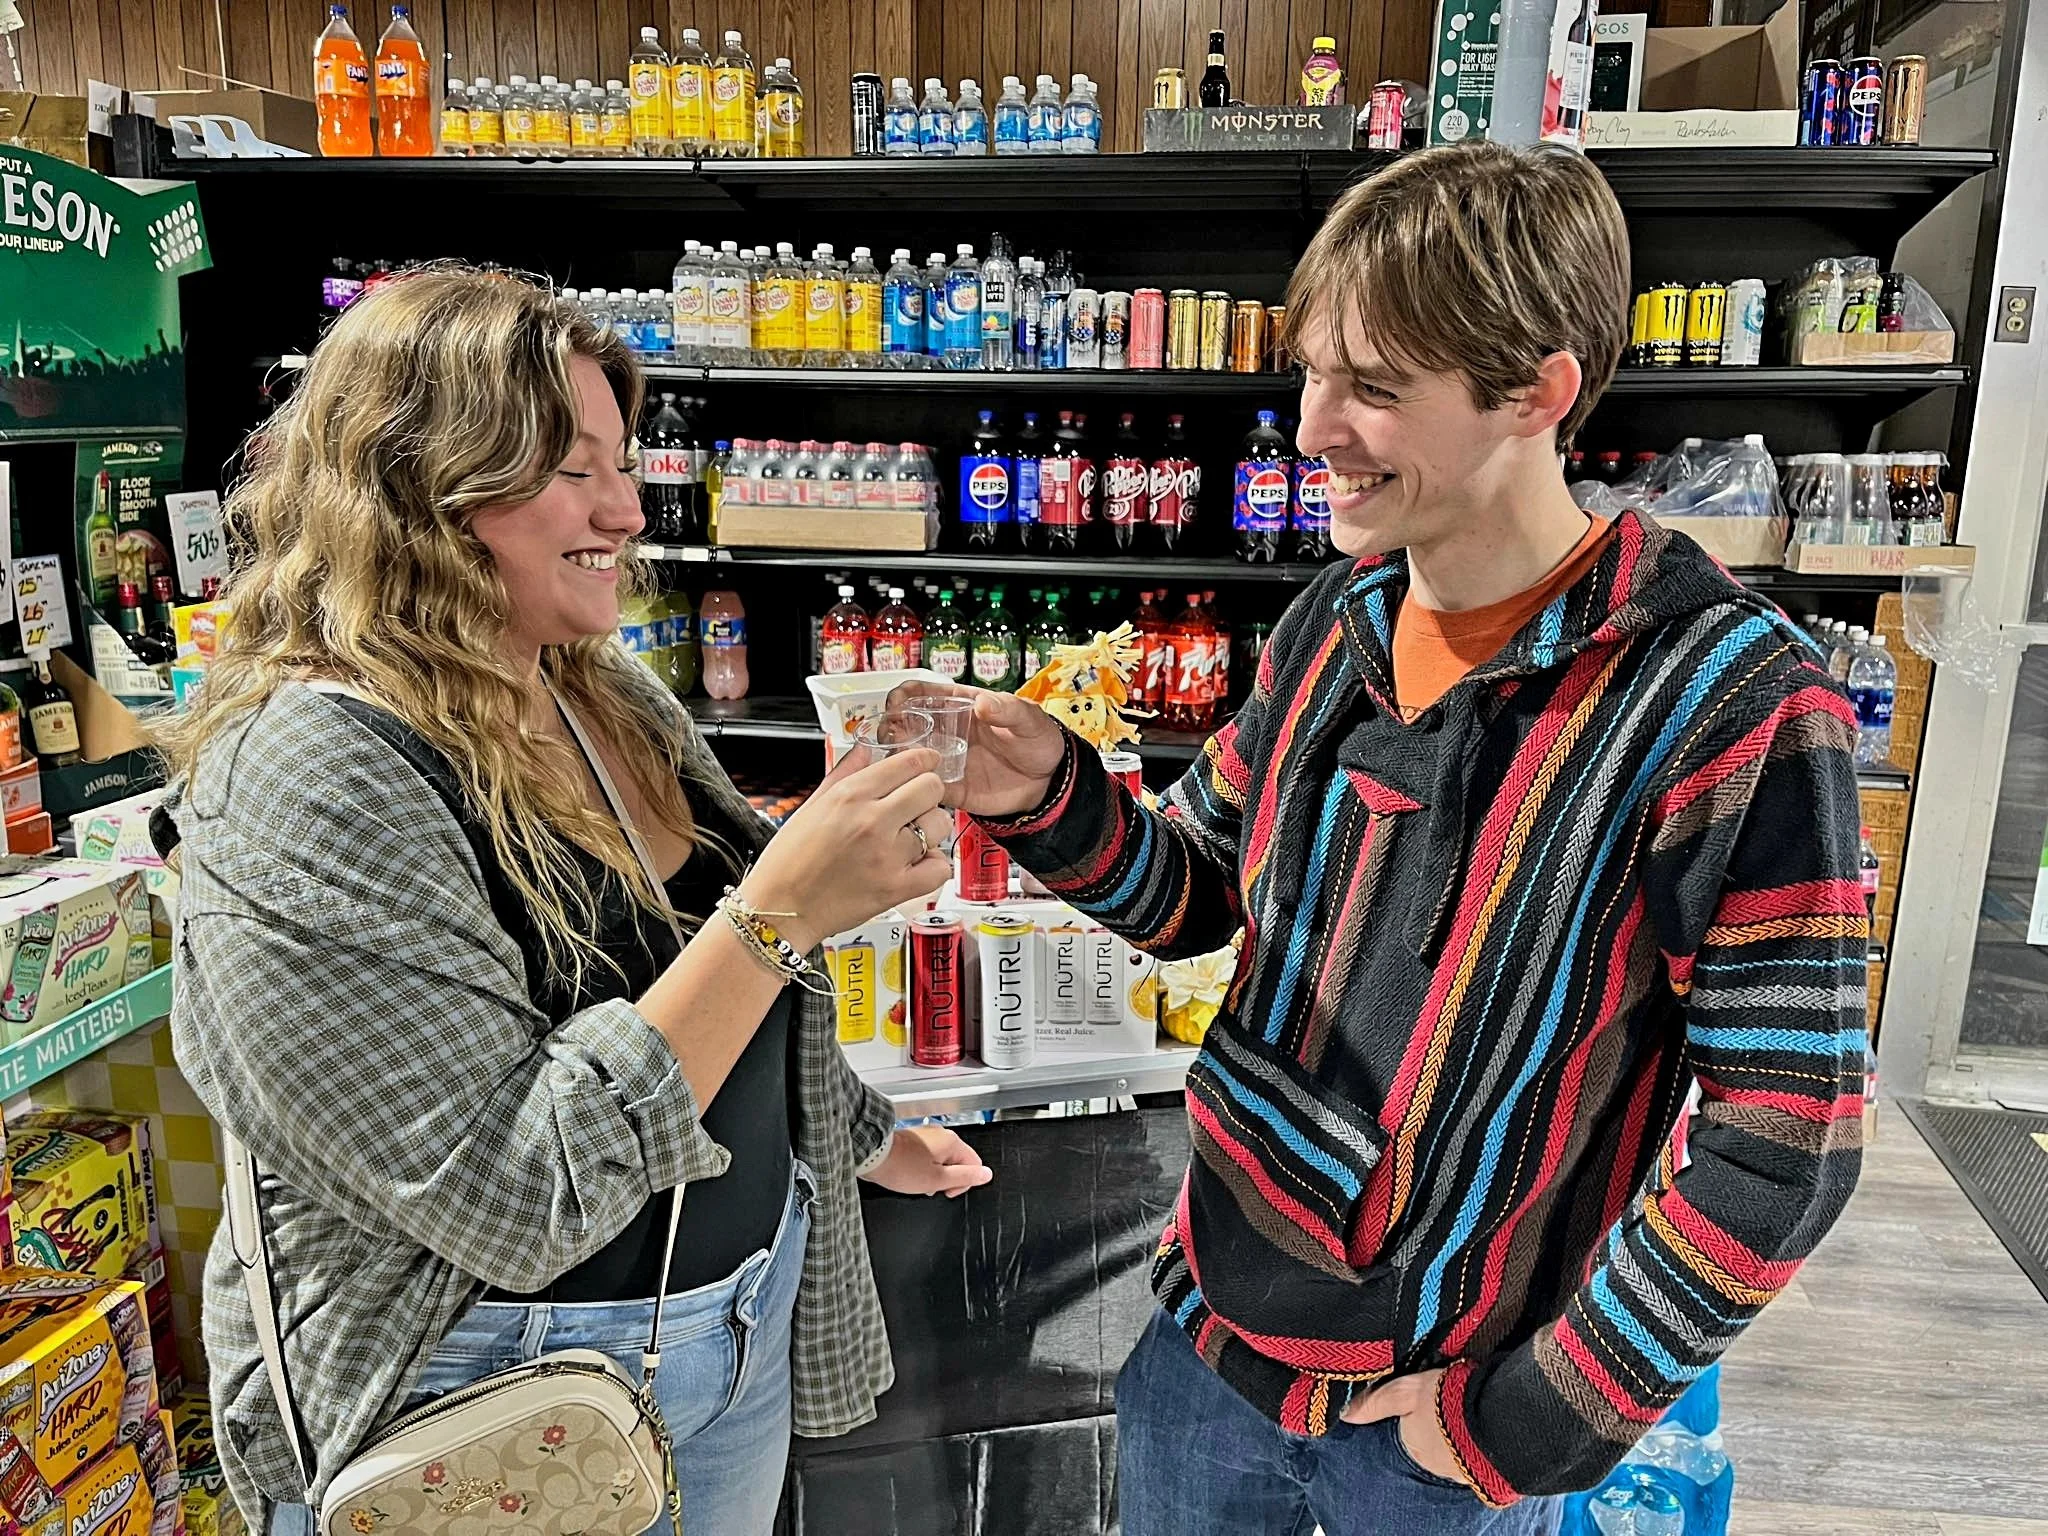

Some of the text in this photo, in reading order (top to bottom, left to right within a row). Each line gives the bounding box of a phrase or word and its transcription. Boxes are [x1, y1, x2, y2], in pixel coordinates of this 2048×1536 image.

[1597, 23, 1629, 34] GOS
[1461, 53, 1497, 64] FOR LIGH
[378, 62, 407, 78] FANTA
[1211, 111, 1323, 131] MONSTER
[1447, 115, 1462, 127] 220
[0, 157, 34, 175] PUT A
[2, 173, 114, 259] ESON
[0, 233, 64, 253] OUR LINEUP
[986, 283, 1004, 293] LIFE
[986, 292, 1004, 301] WTR
[120, 477, 151, 489] FLOCK
[973, 481, 1006, 491] PEPSI
[120, 487, 151, 500] TO THE
[1302, 488, 1327, 498] PEP
[120, 498, 157, 512] SMOOTH
[119, 511, 139, 523] SIDE
[4, 927, 14, 938] 12
[58, 911, 112, 951] AriZona
[891, 926, 900, 940] 8
[64, 945, 110, 989] HARD
[1036, 1028, 1053, 1036] tzer,
[0, 1063, 27, 1096] TE
[141, 1147, 156, 1224] PARTY PACK
[46, 1334, 94, 1370] ORIGINAL
[40, 1343, 102, 1414] AriZona
[51, 1380, 103, 1441] HARD
[45, 1406, 109, 1460] Juice Cocktails
[77, 1466, 123, 1505] ORIGINAL
[72, 1474, 131, 1536] AriZona
